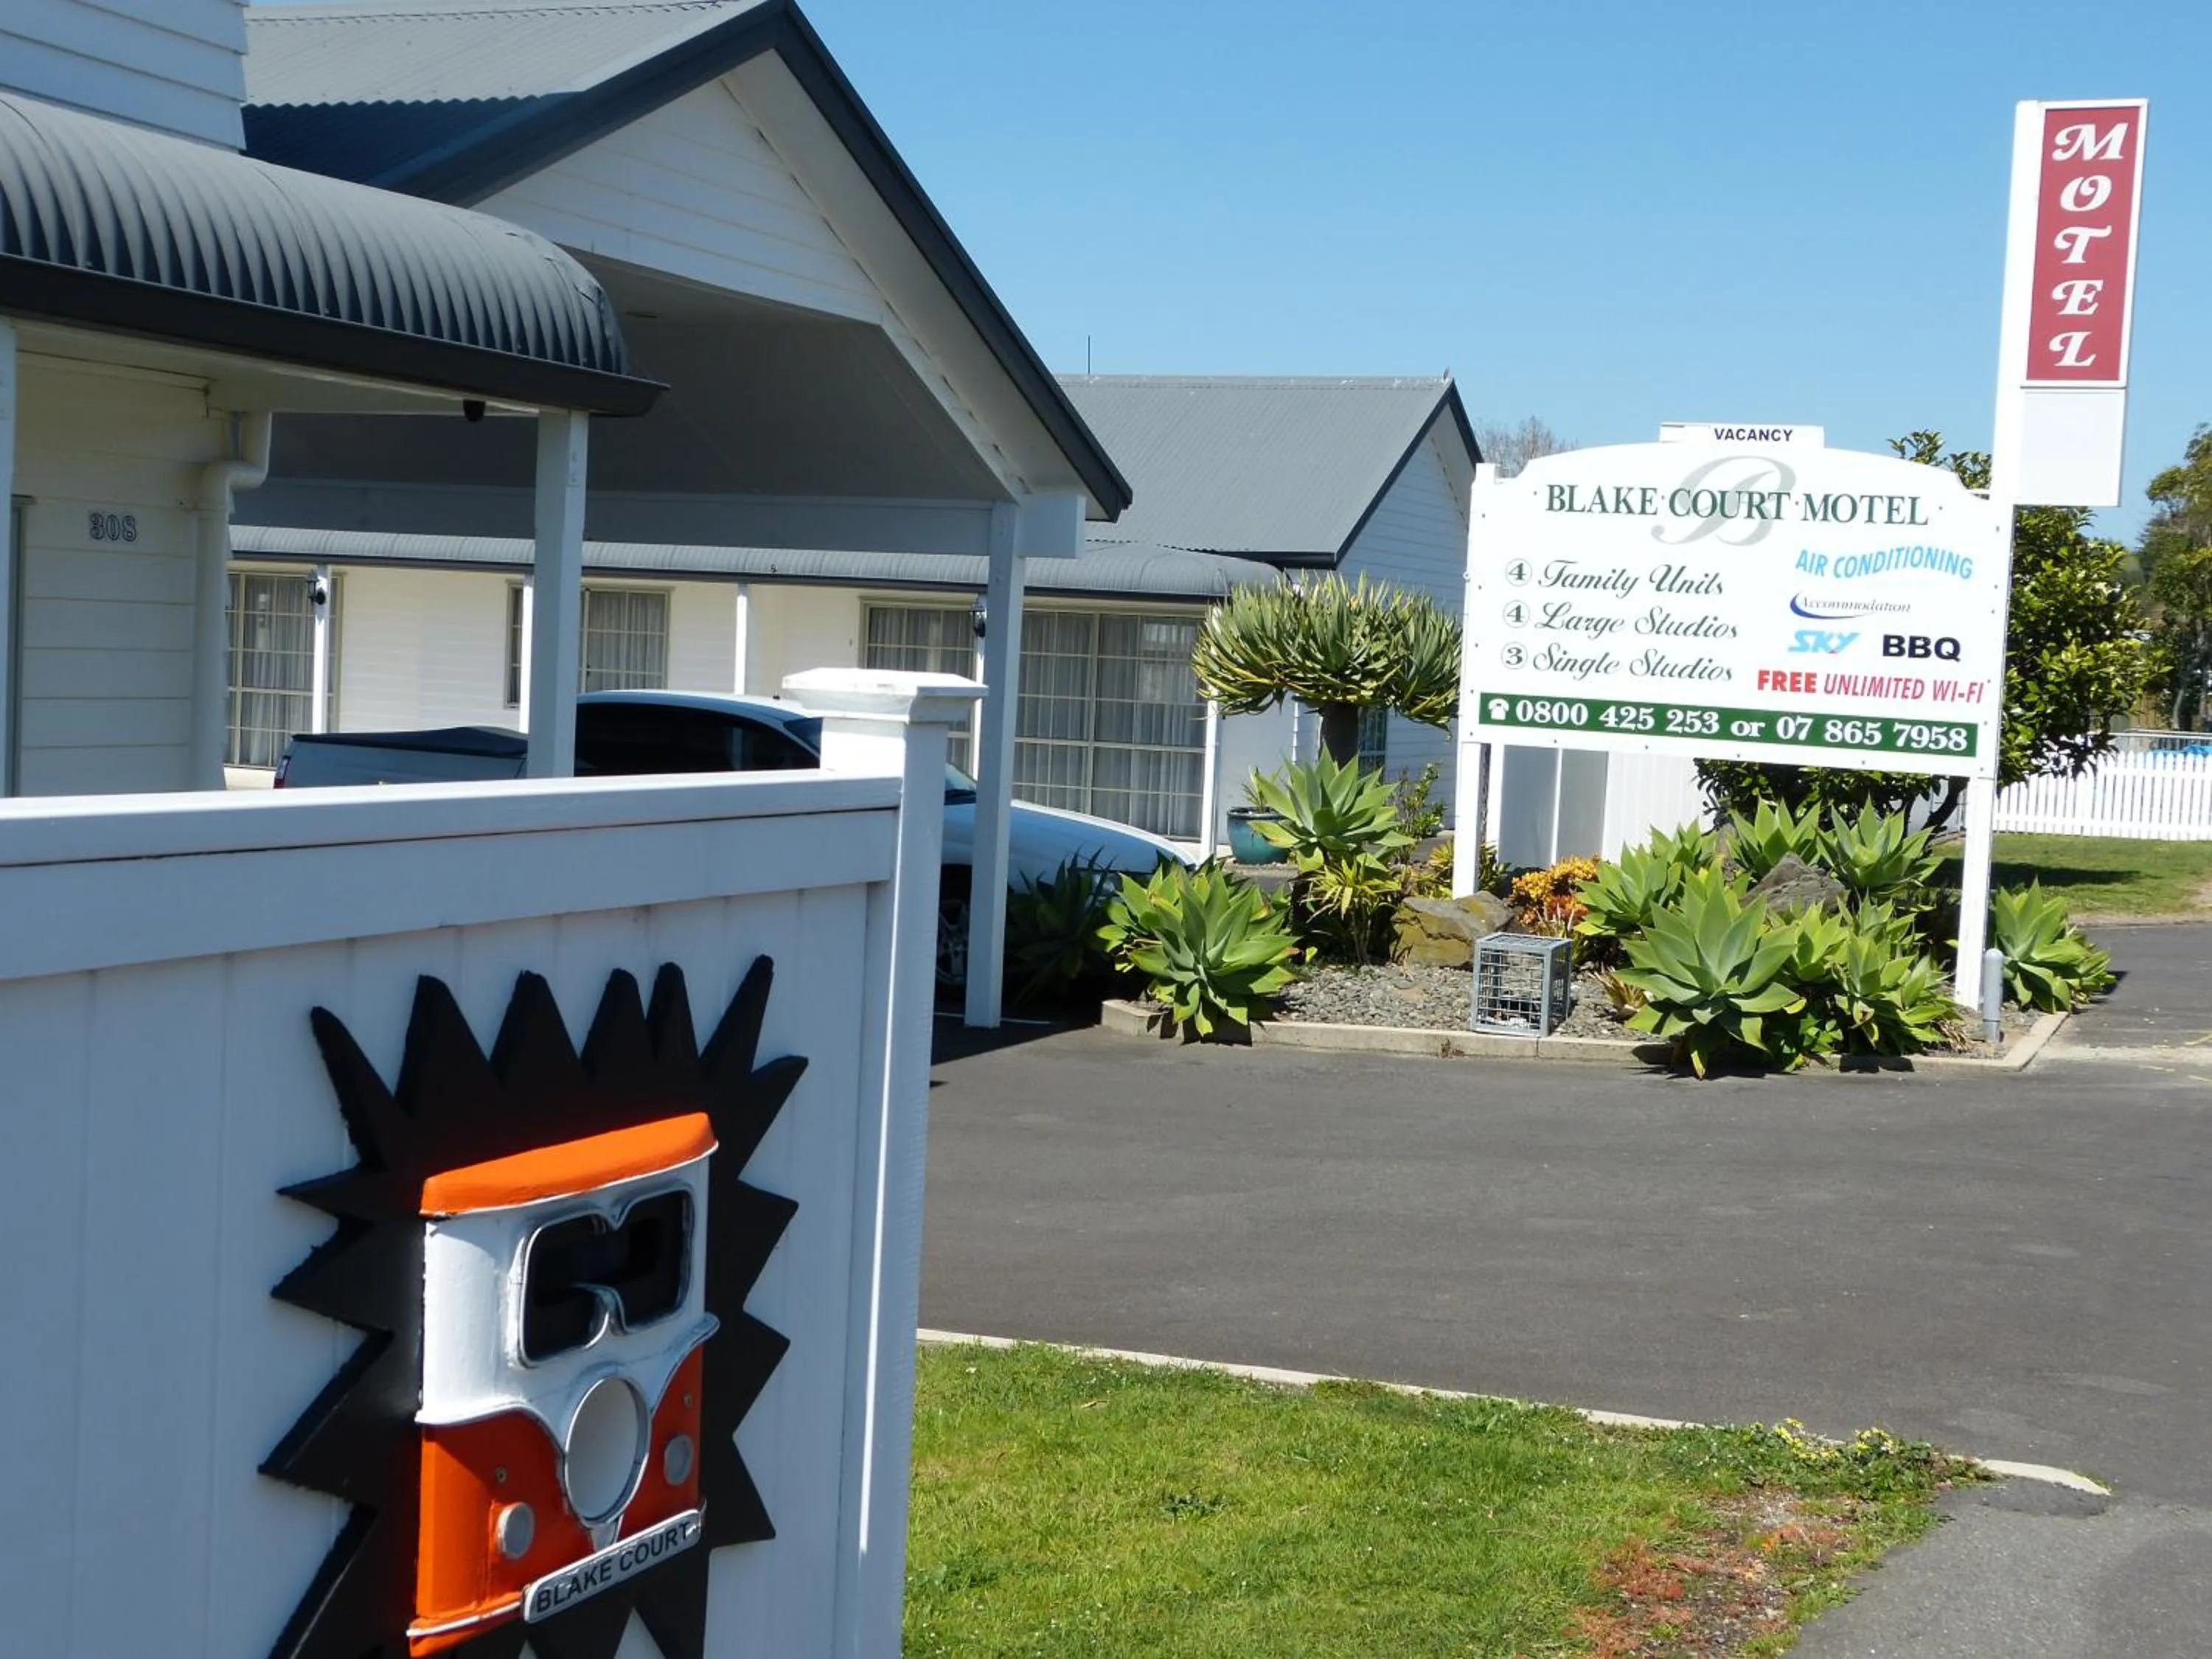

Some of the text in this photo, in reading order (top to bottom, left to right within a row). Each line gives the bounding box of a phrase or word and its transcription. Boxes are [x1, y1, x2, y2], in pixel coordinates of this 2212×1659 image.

[2048, 122, 2129, 367] MOTEL
[1714, 428, 1794, 442] VACANCY
[1545, 484, 1929, 526] BLAKE COURT MOTEL
[1508, 560, 1724, 599] 4 Family Units
[1795, 546, 1975, 580] AIR CONDITIONING
[1506, 602, 1738, 640] 4 Large Studios
[1799, 596, 1911, 613] Accommodation
[1787, 629, 1861, 654] SKY
[1882, 633, 1961, 663] BBQ
[1505, 642, 1733, 681] 3 Single Studios
[1757, 669, 1984, 704] FREE UNLIMITED WI-FI
[1514, 700, 1968, 751] 0800 425 253 or 07 865 7958
[536, 1521, 691, 1613] BLAKE COURT
